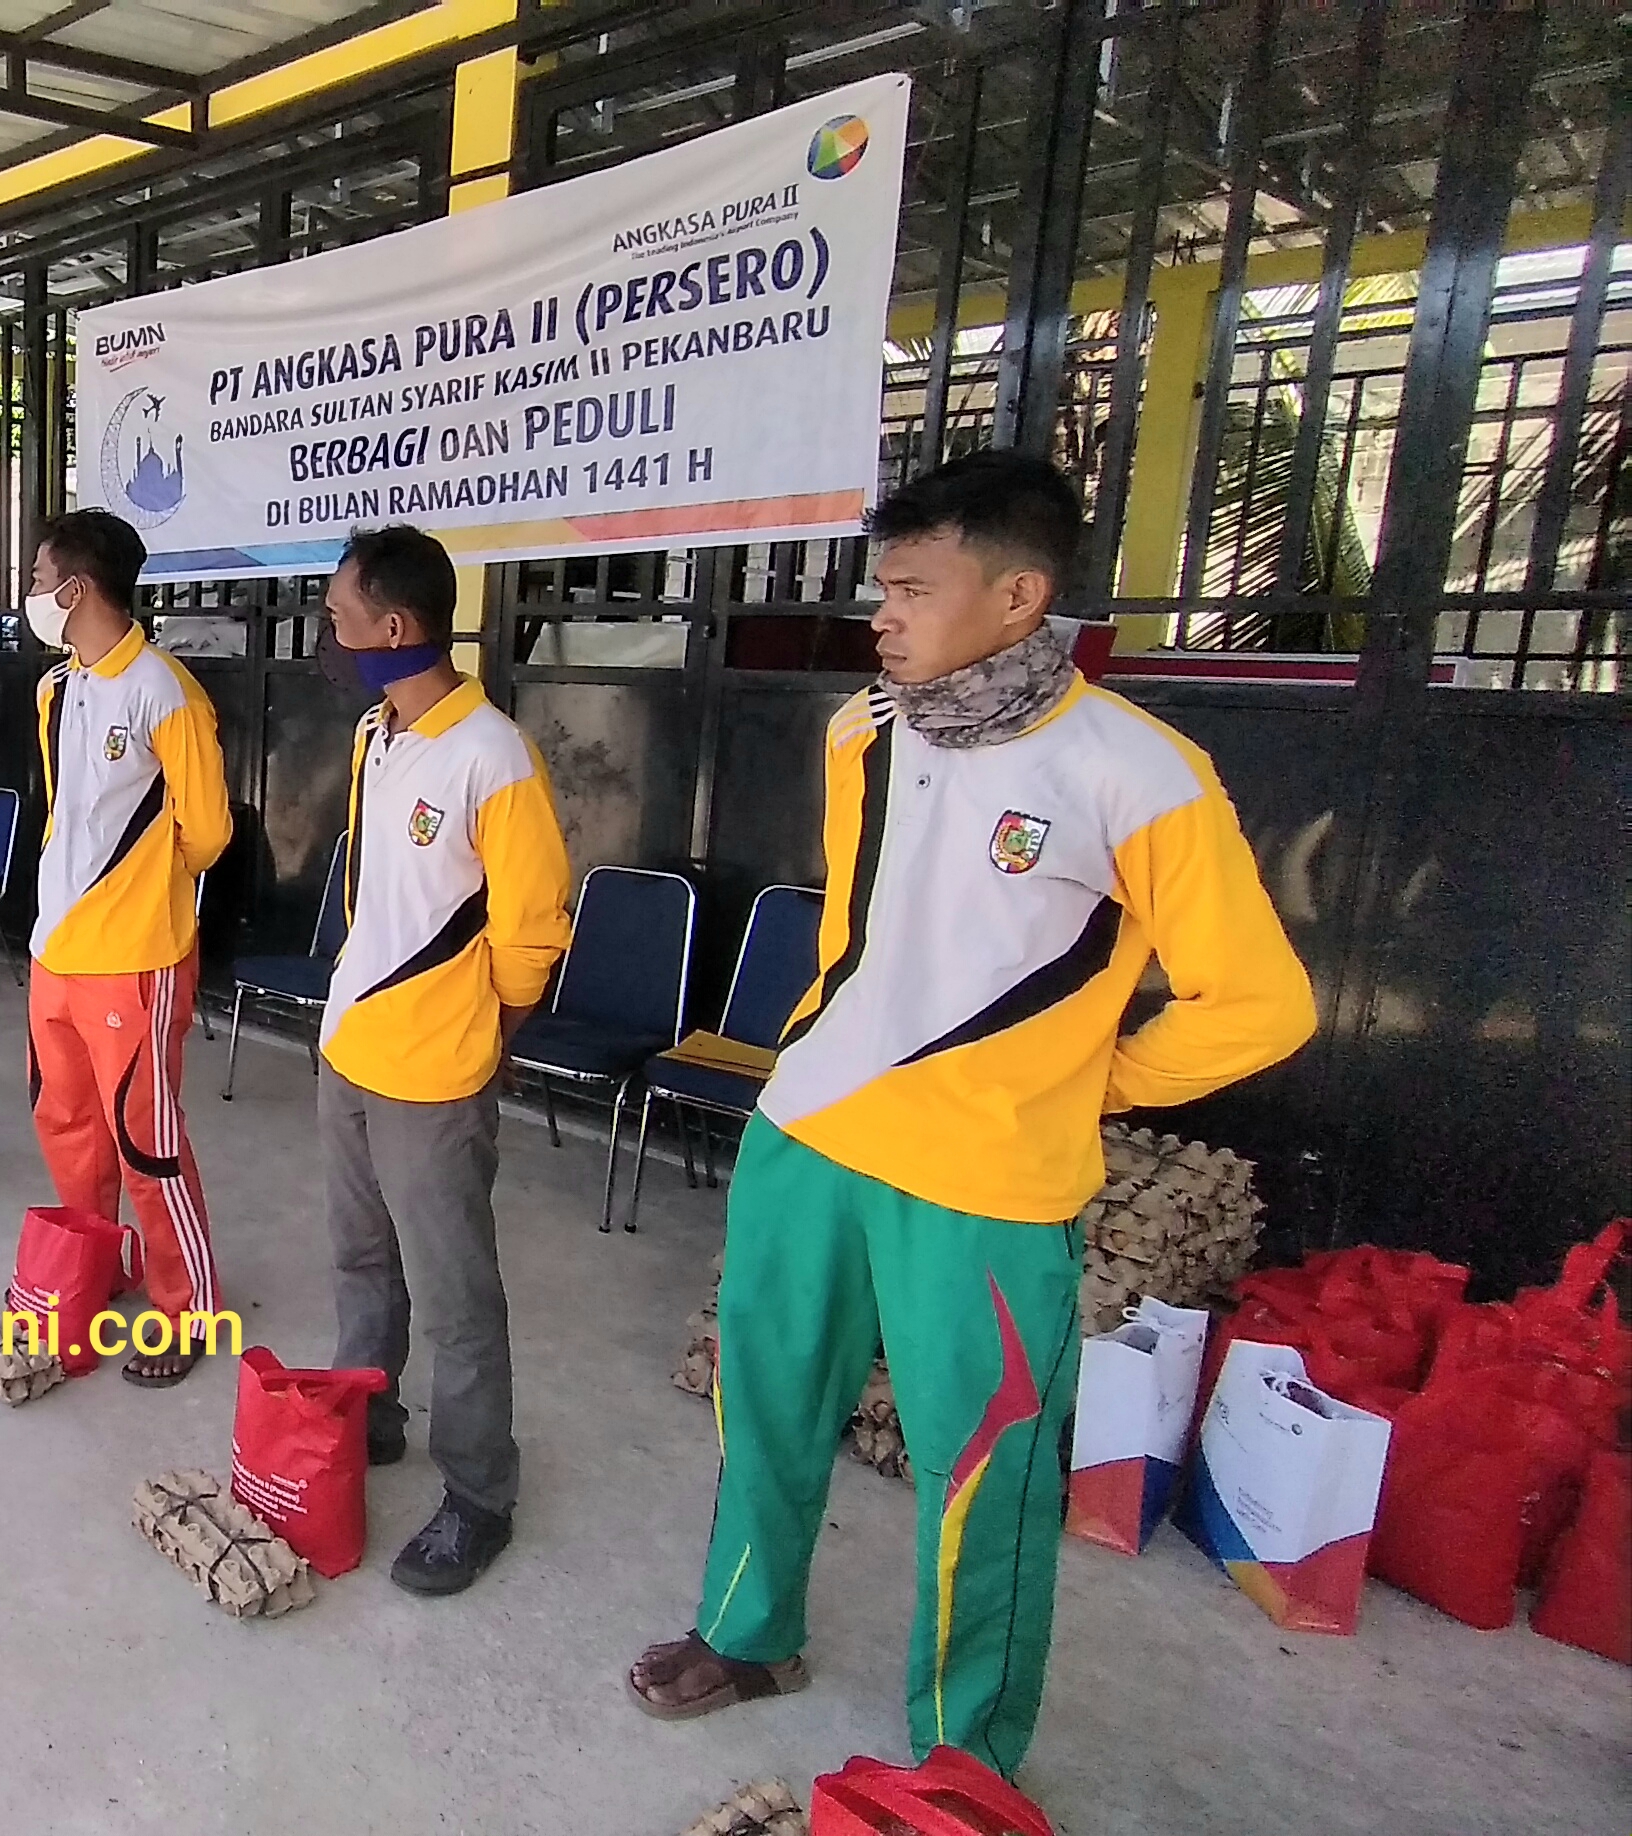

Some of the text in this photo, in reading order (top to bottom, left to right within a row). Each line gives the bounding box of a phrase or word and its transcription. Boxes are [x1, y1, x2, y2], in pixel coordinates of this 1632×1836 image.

[612, 183, 800, 253] ANGKASA PURA II
[95, 322, 166, 356] BUMN
[210, 226, 830, 406] PT ANGKASA PURA II (PERSERO)
[210, 305, 830, 442] BANDARA SULTAN SYARIF KASIM II PEKANBARU
[290, 426, 430, 482] BERBAGI
[524, 384, 676, 450] PEDULI
[266, 447, 713, 527] DI BULAN RAMADHAN 1441 H
